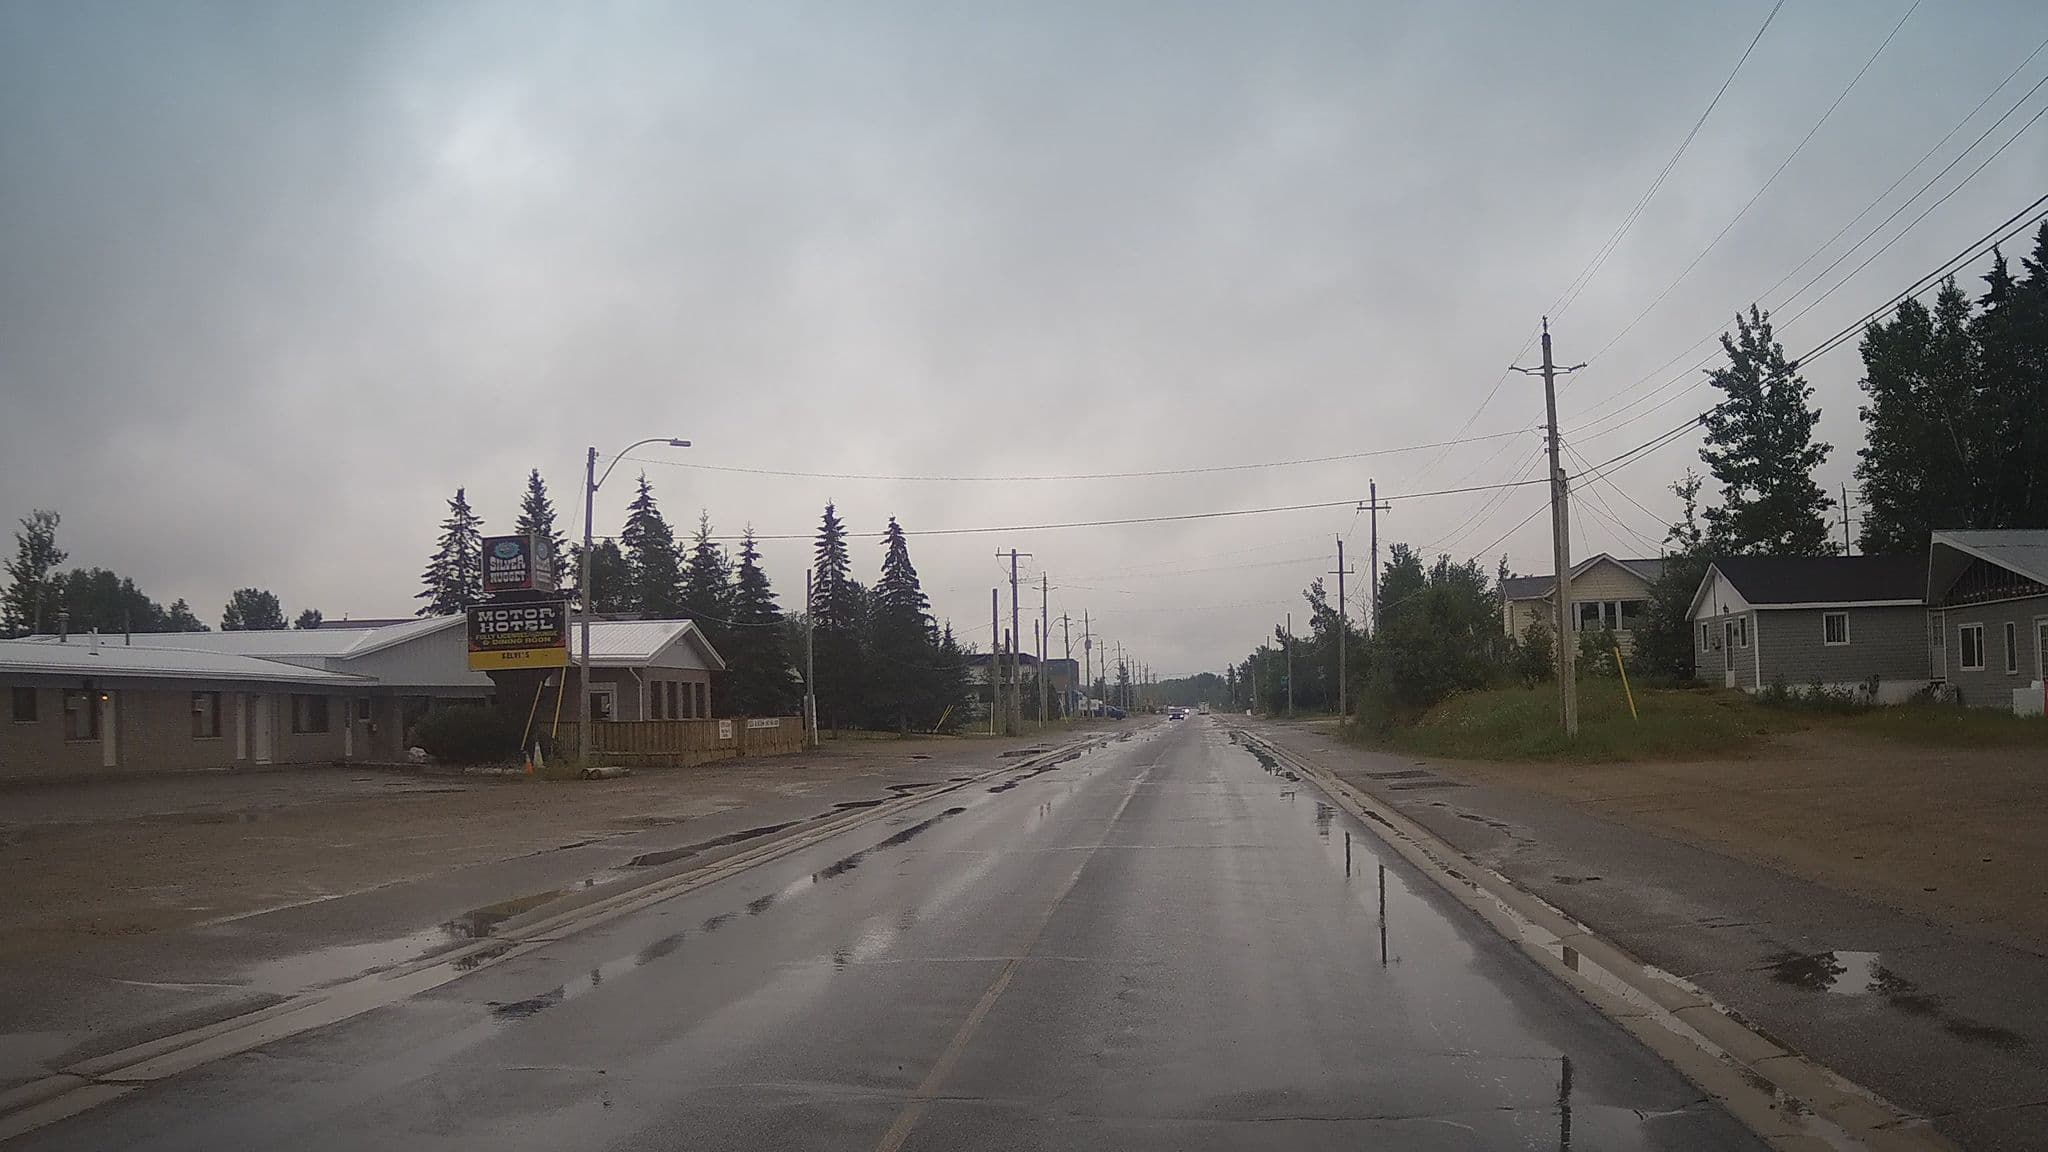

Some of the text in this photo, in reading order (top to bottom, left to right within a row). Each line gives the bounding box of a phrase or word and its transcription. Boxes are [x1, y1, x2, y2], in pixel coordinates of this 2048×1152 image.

[489, 554, 526, 570] SILVER
[490, 571, 526, 583] NUGGET
[478, 608, 555, 622] MOTOR
[479, 620, 554, 632] HOTEL
[475, 633, 495, 641] FULLY
